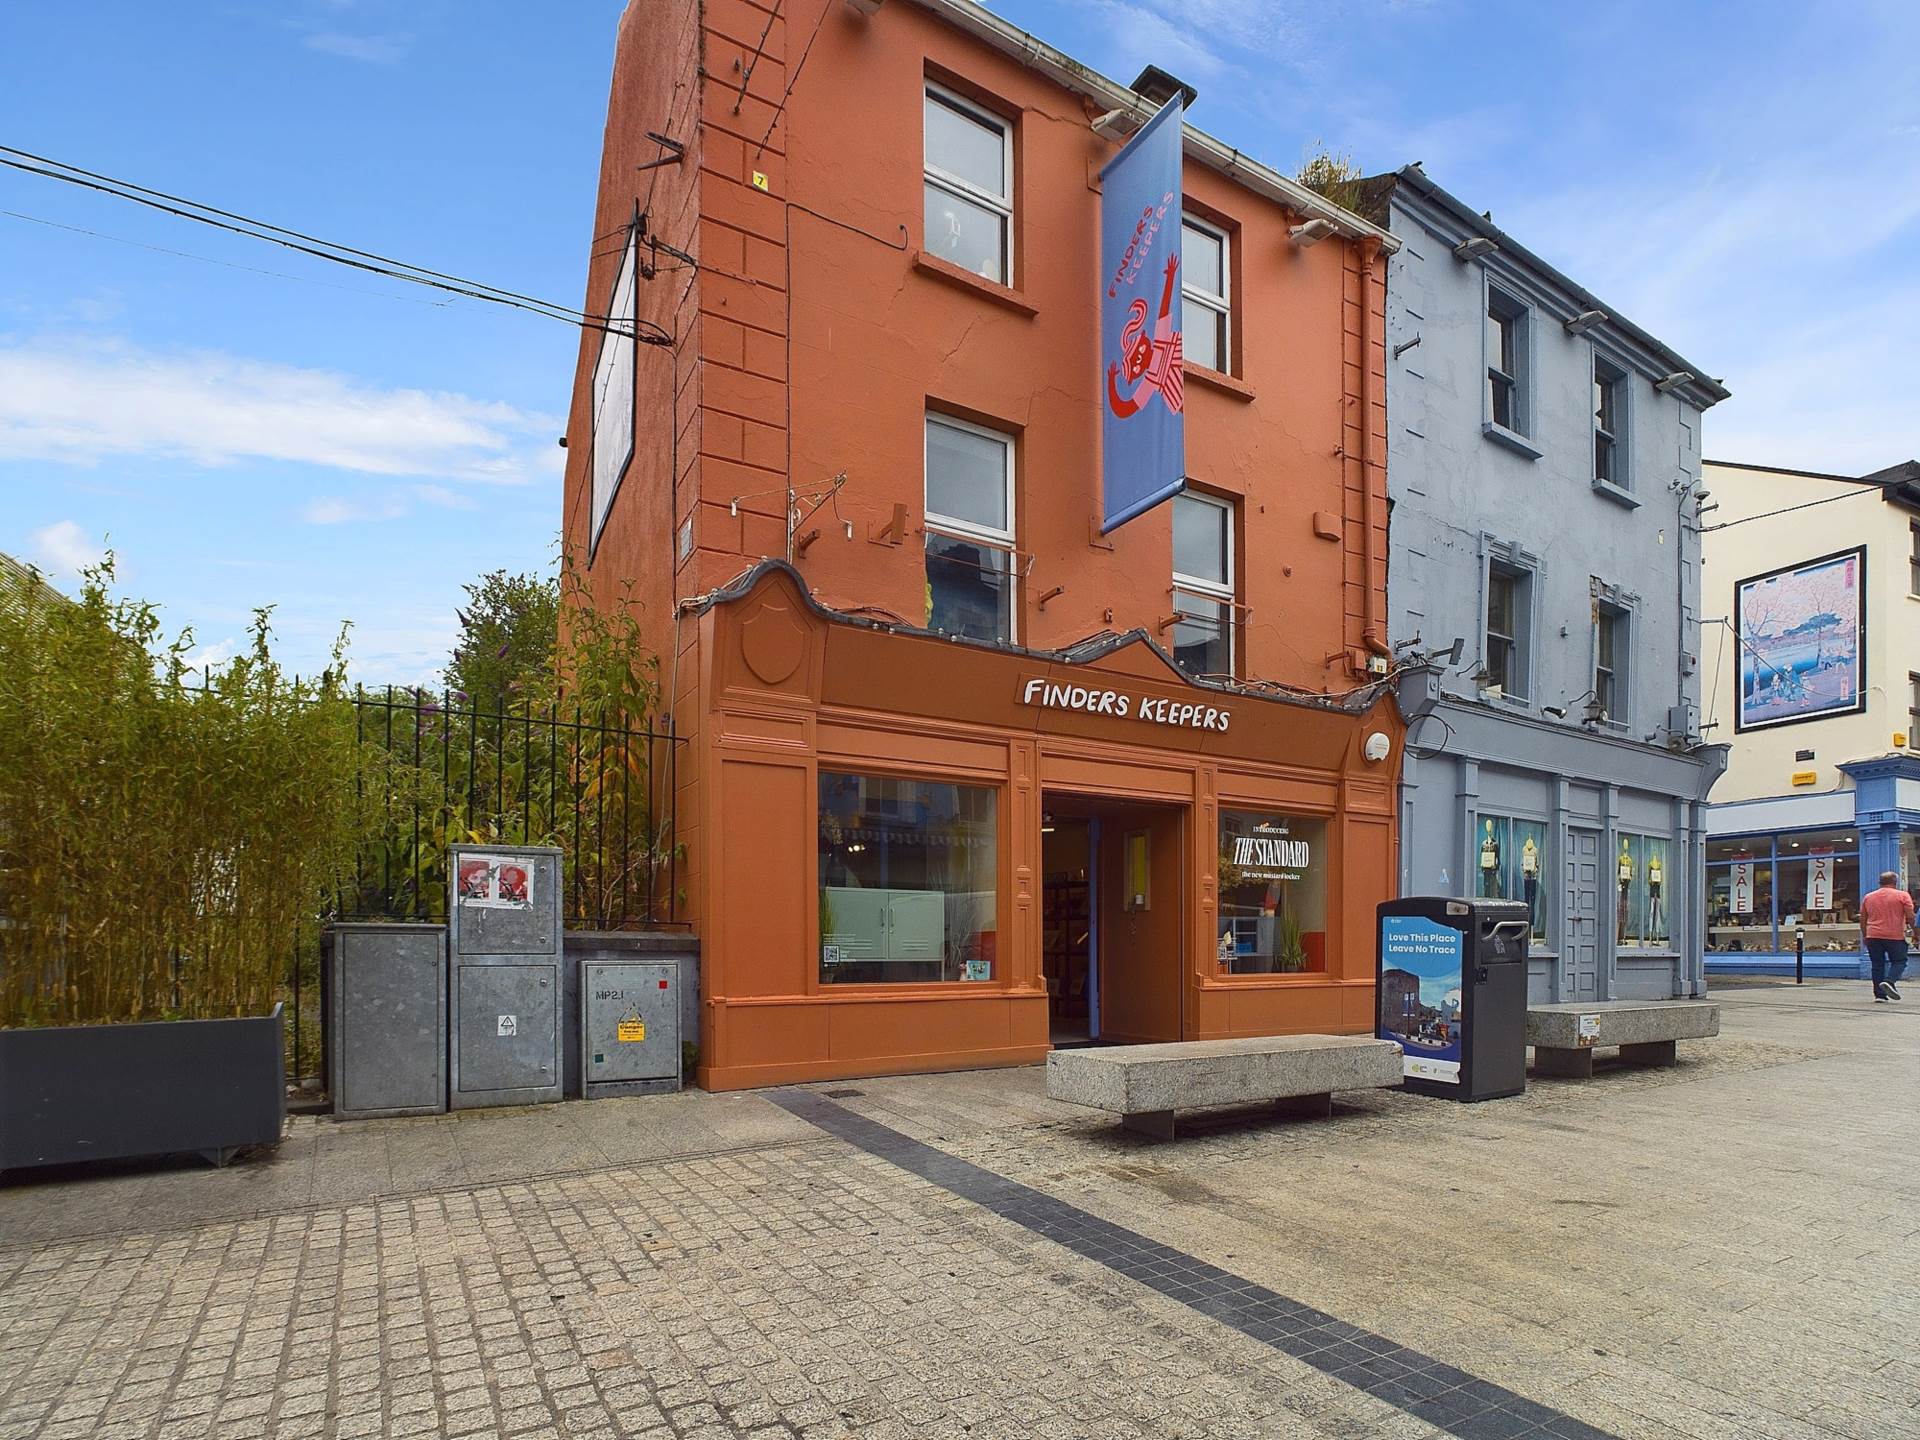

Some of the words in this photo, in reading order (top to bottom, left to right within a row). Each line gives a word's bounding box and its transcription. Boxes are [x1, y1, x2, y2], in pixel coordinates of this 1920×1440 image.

[757, 175, 764, 186] 7
[1109, 205, 1153, 298] FINDERS
[1126, 191, 1174, 285] KEEPERS
[1023, 678, 1130, 716] FINDERS
[1138, 697, 1231, 732] KEEPERS
[1233, 837, 1256, 865] THE
[1255, 838, 1309, 868] STANDARD
[1736, 863, 1748, 912] SALE
[1813, 858, 1827, 909] SALE
[1388, 944, 1414, 953] Leave
[1415, 945, 1429, 953] No
[1429, 945, 1456, 954] Trace
[1389, 933, 1409, 942] Love
[1410, 933, 1430, 943] This
[1430, 934, 1456, 943] Place
